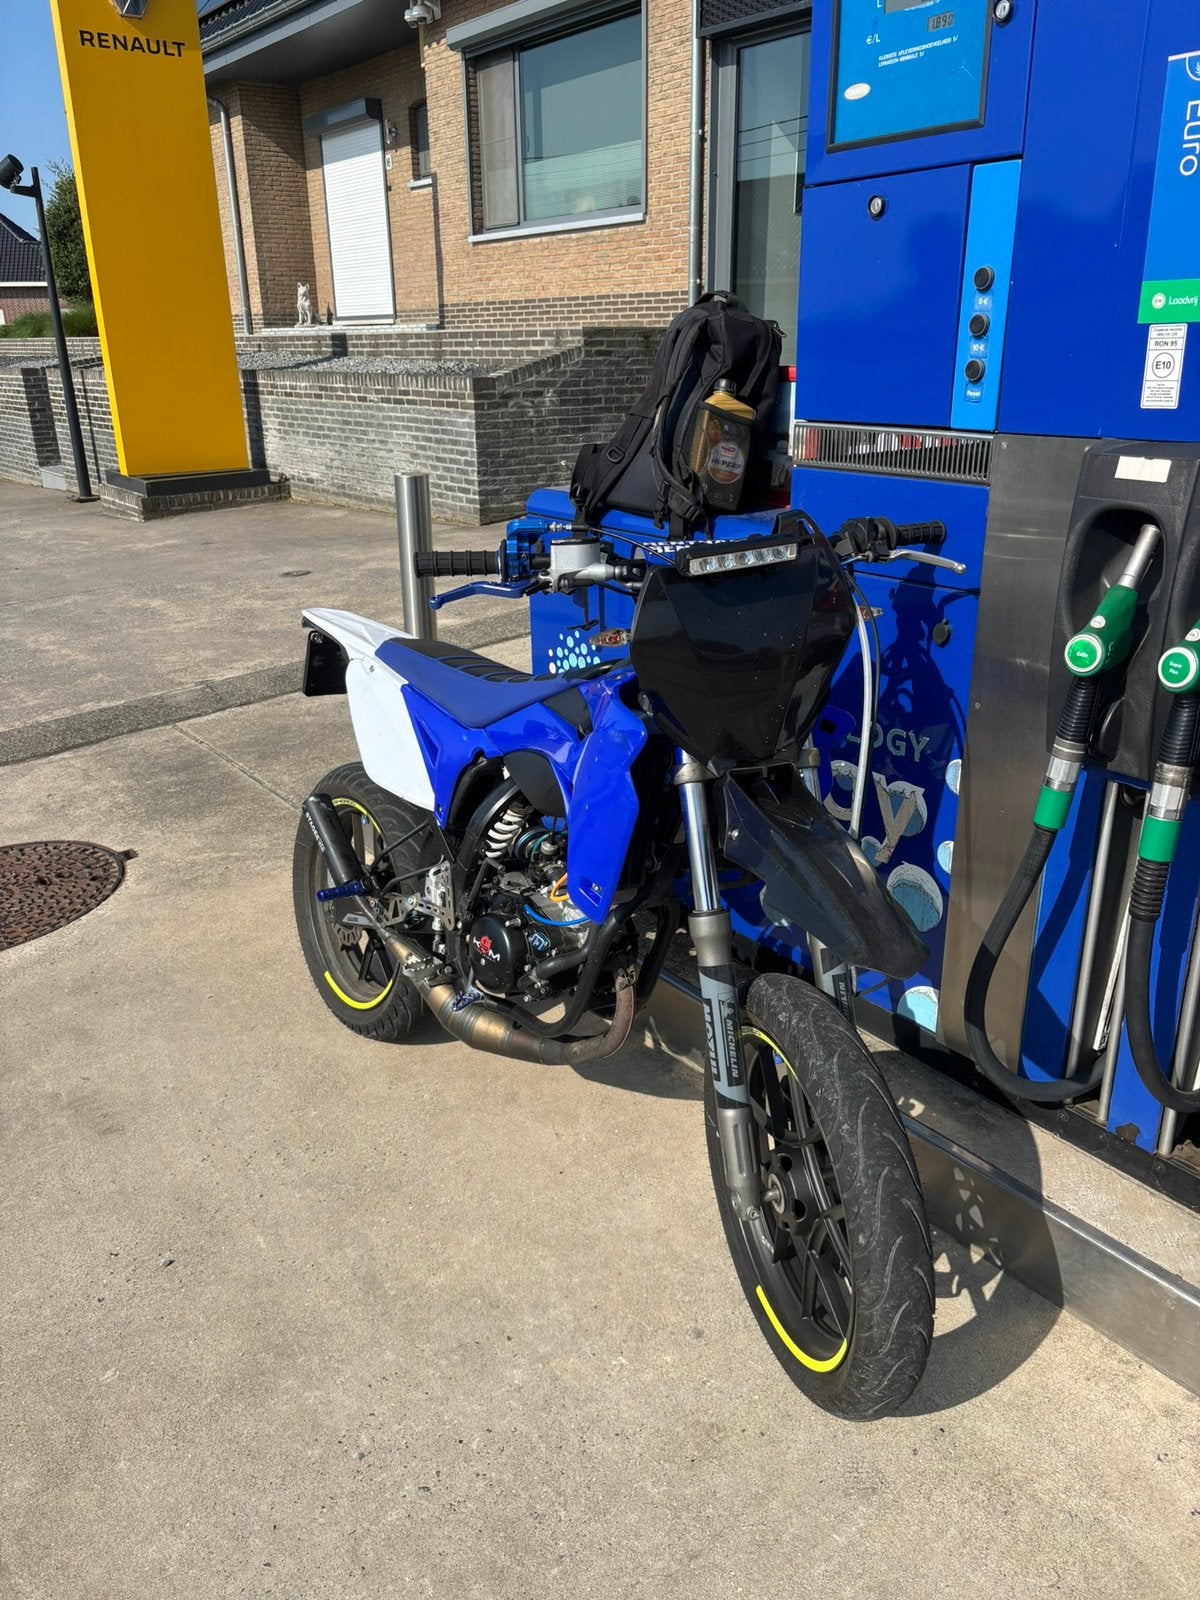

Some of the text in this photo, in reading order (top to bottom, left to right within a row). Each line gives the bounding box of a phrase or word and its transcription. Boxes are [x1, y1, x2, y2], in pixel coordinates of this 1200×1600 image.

[78, 29, 186, 57] RENAULT
[866, 33, 881, 45] €/L
[1154, 340, 1169, 348] RON
[1155, 360, 1172, 370] E10
[725, 1019, 739, 1078] MICHELIN
